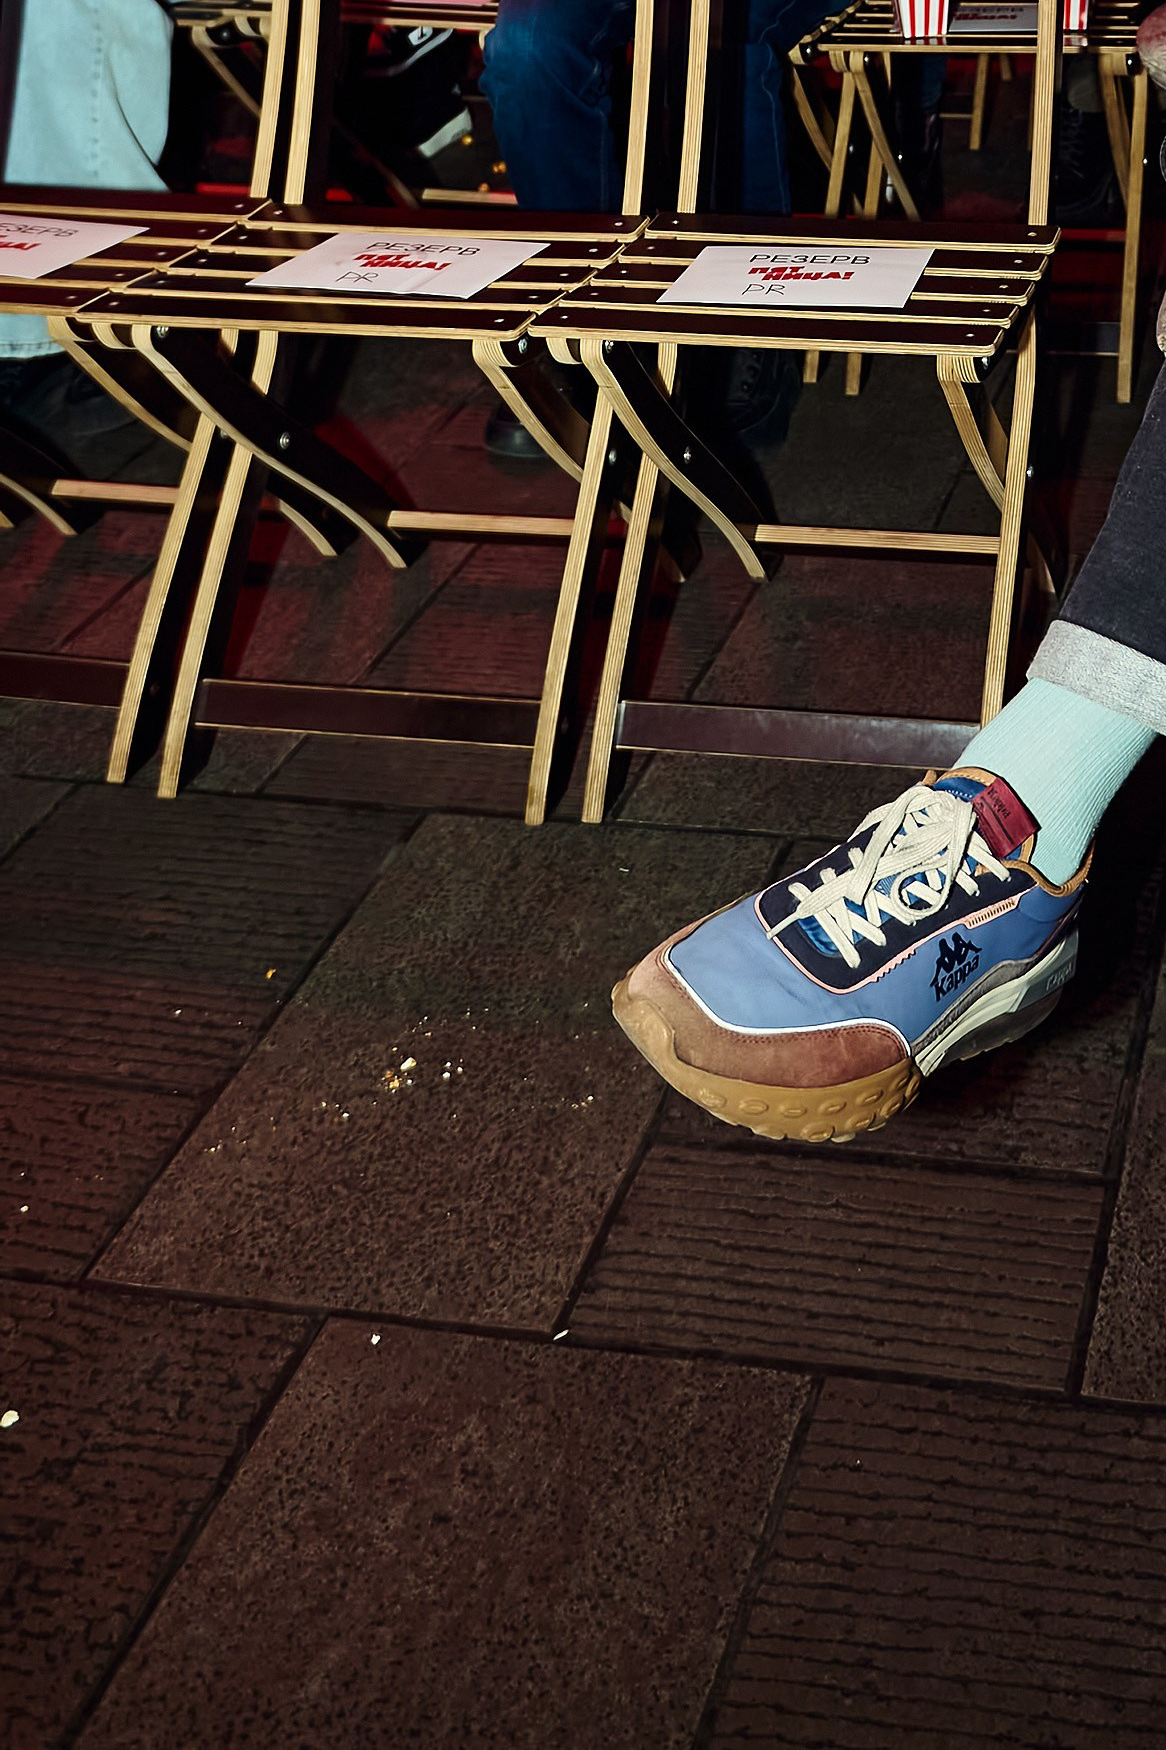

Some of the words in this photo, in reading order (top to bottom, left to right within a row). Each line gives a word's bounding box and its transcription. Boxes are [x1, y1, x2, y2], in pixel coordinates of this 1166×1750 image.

[0, 222, 78, 237] ЕЗЕРВ
[366, 241, 480, 256] РЕЗЕРВ
[749, 254, 871, 265] РЕЗЕРВ
[741, 283, 786, 296] PR
[934, 954, 980, 1002] Kappa
